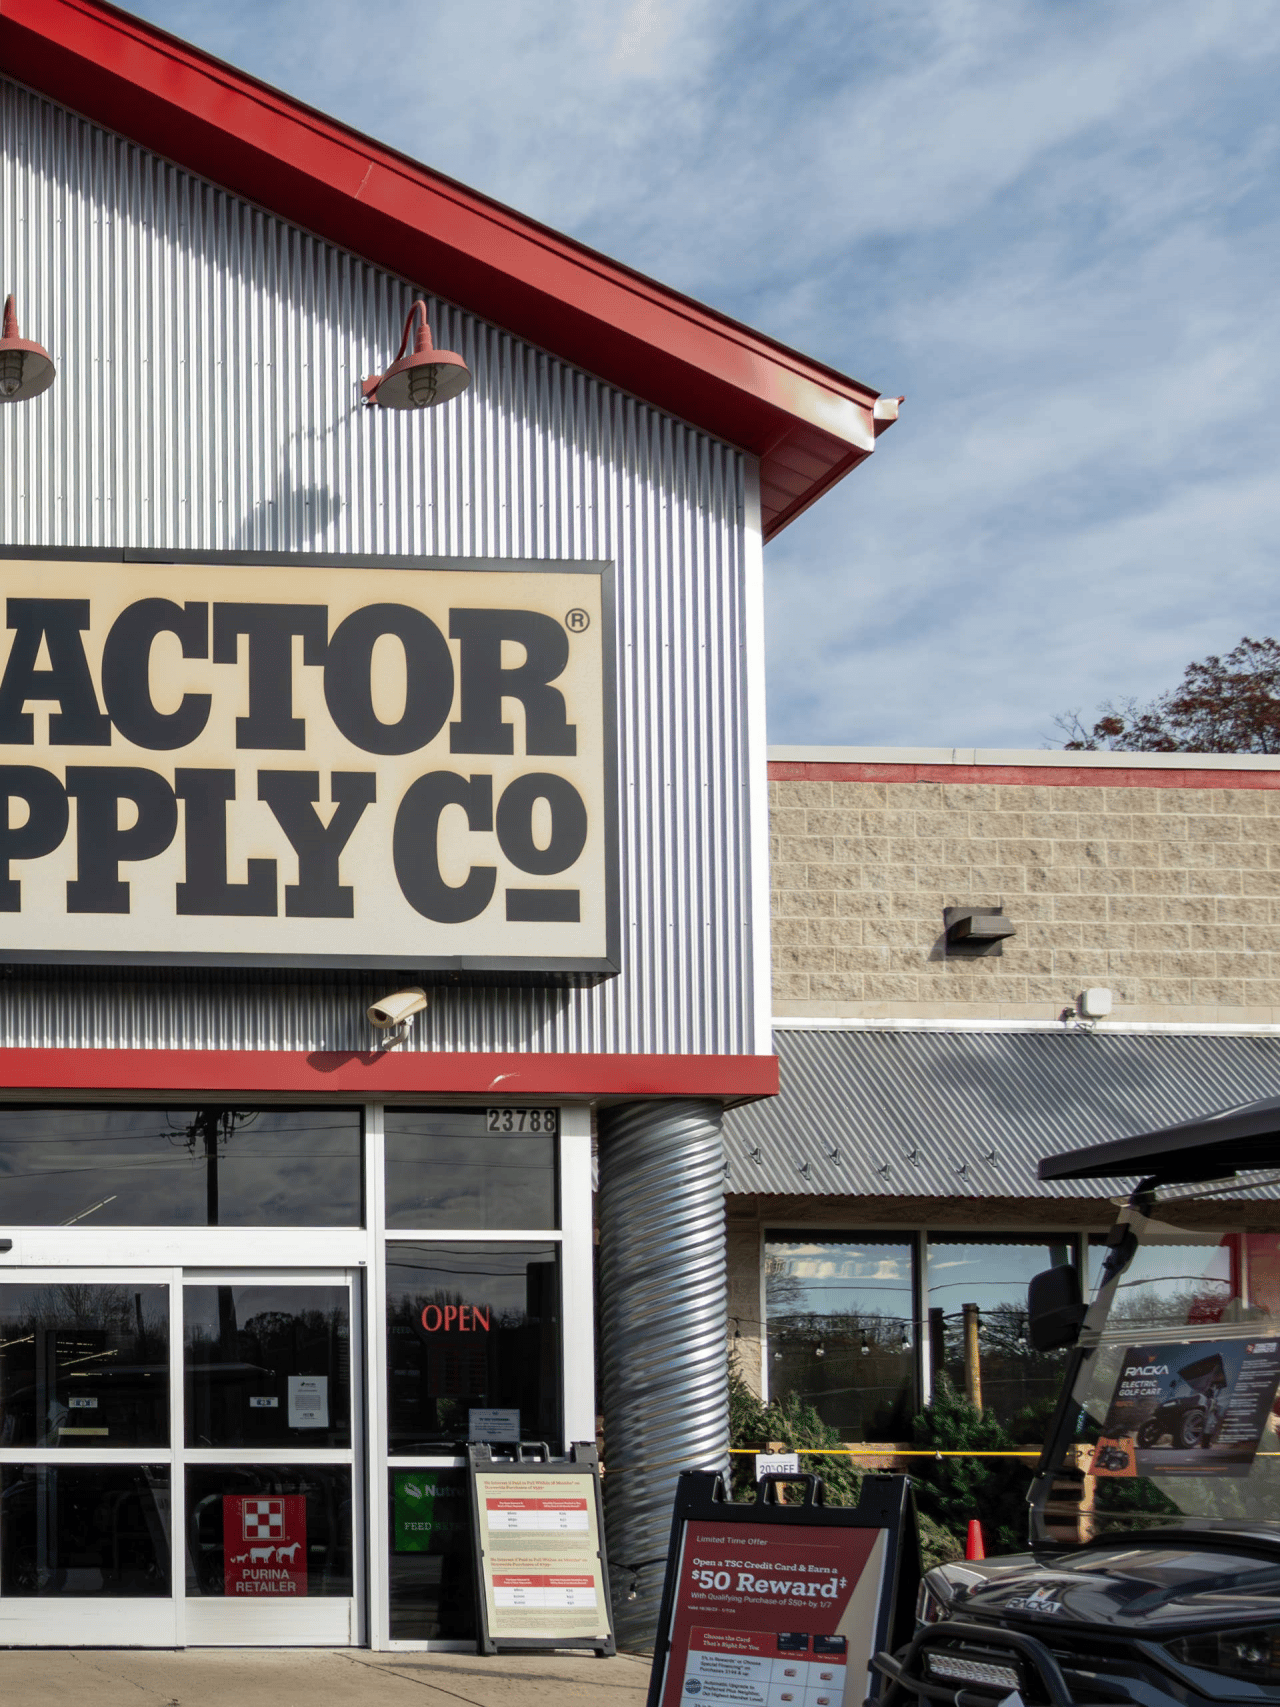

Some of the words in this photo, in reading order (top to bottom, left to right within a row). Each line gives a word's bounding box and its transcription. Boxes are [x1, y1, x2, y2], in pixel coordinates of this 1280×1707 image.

[489, 1109, 555, 1132] 23788
[421, 1305, 490, 1332] OPEN
[1124, 1365, 1169, 1377] RACKA
[1121, 1379, 1158, 1389] ELECTRIC
[1141, 1387, 1162, 1395] CART
[776, 1464, 795, 1474] OFF
[404, 1521, 432, 1530] FEED
[696, 1535, 725, 1544] Limited
[726, 1537, 746, 1545] Time
[693, 1558, 716, 1568] Open
[724, 1559, 743, 1568] TSC
[744, 1561, 773, 1570] Credit
[774, 1562, 797, 1571] Card
[798, 1564, 806, 1572] &
[807, 1565, 830, 1573] Earn
[242, 1568, 290, 1579] PURINA
[691, 1569, 731, 1590] $50
[236, 1581, 296, 1592] RETAILER
[690, 1591, 707, 1599] With
[707, 1593, 743, 1604] Qualifying
[743, 1595, 778, 1605] Purchase
[778, 1597, 787, 1605] of
[787, 1598, 807, 1607] $50+
[808, 1599, 818, 1609] by
[1008, 1598, 1056, 1612] RACKA
[721, 1641, 738, 1649] Right
